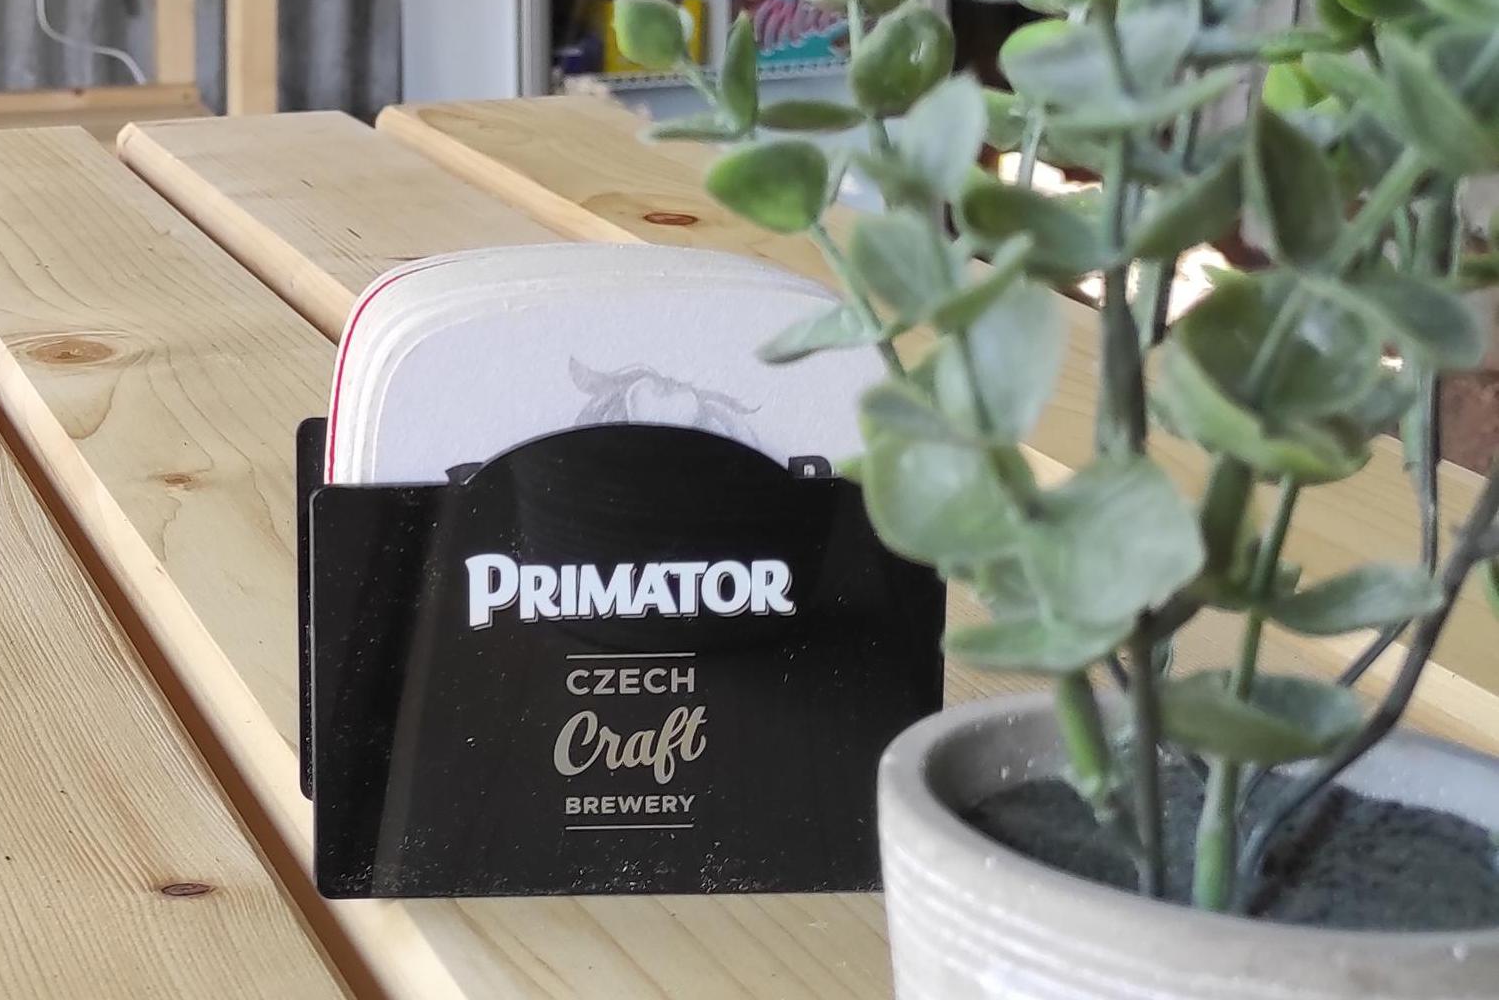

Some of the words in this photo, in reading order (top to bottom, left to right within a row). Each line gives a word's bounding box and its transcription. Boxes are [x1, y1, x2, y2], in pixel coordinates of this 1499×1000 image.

[566, 667, 695, 695] CZECH
[553, 705, 708, 785] Craft
[565, 794, 696, 815] BREWERY
